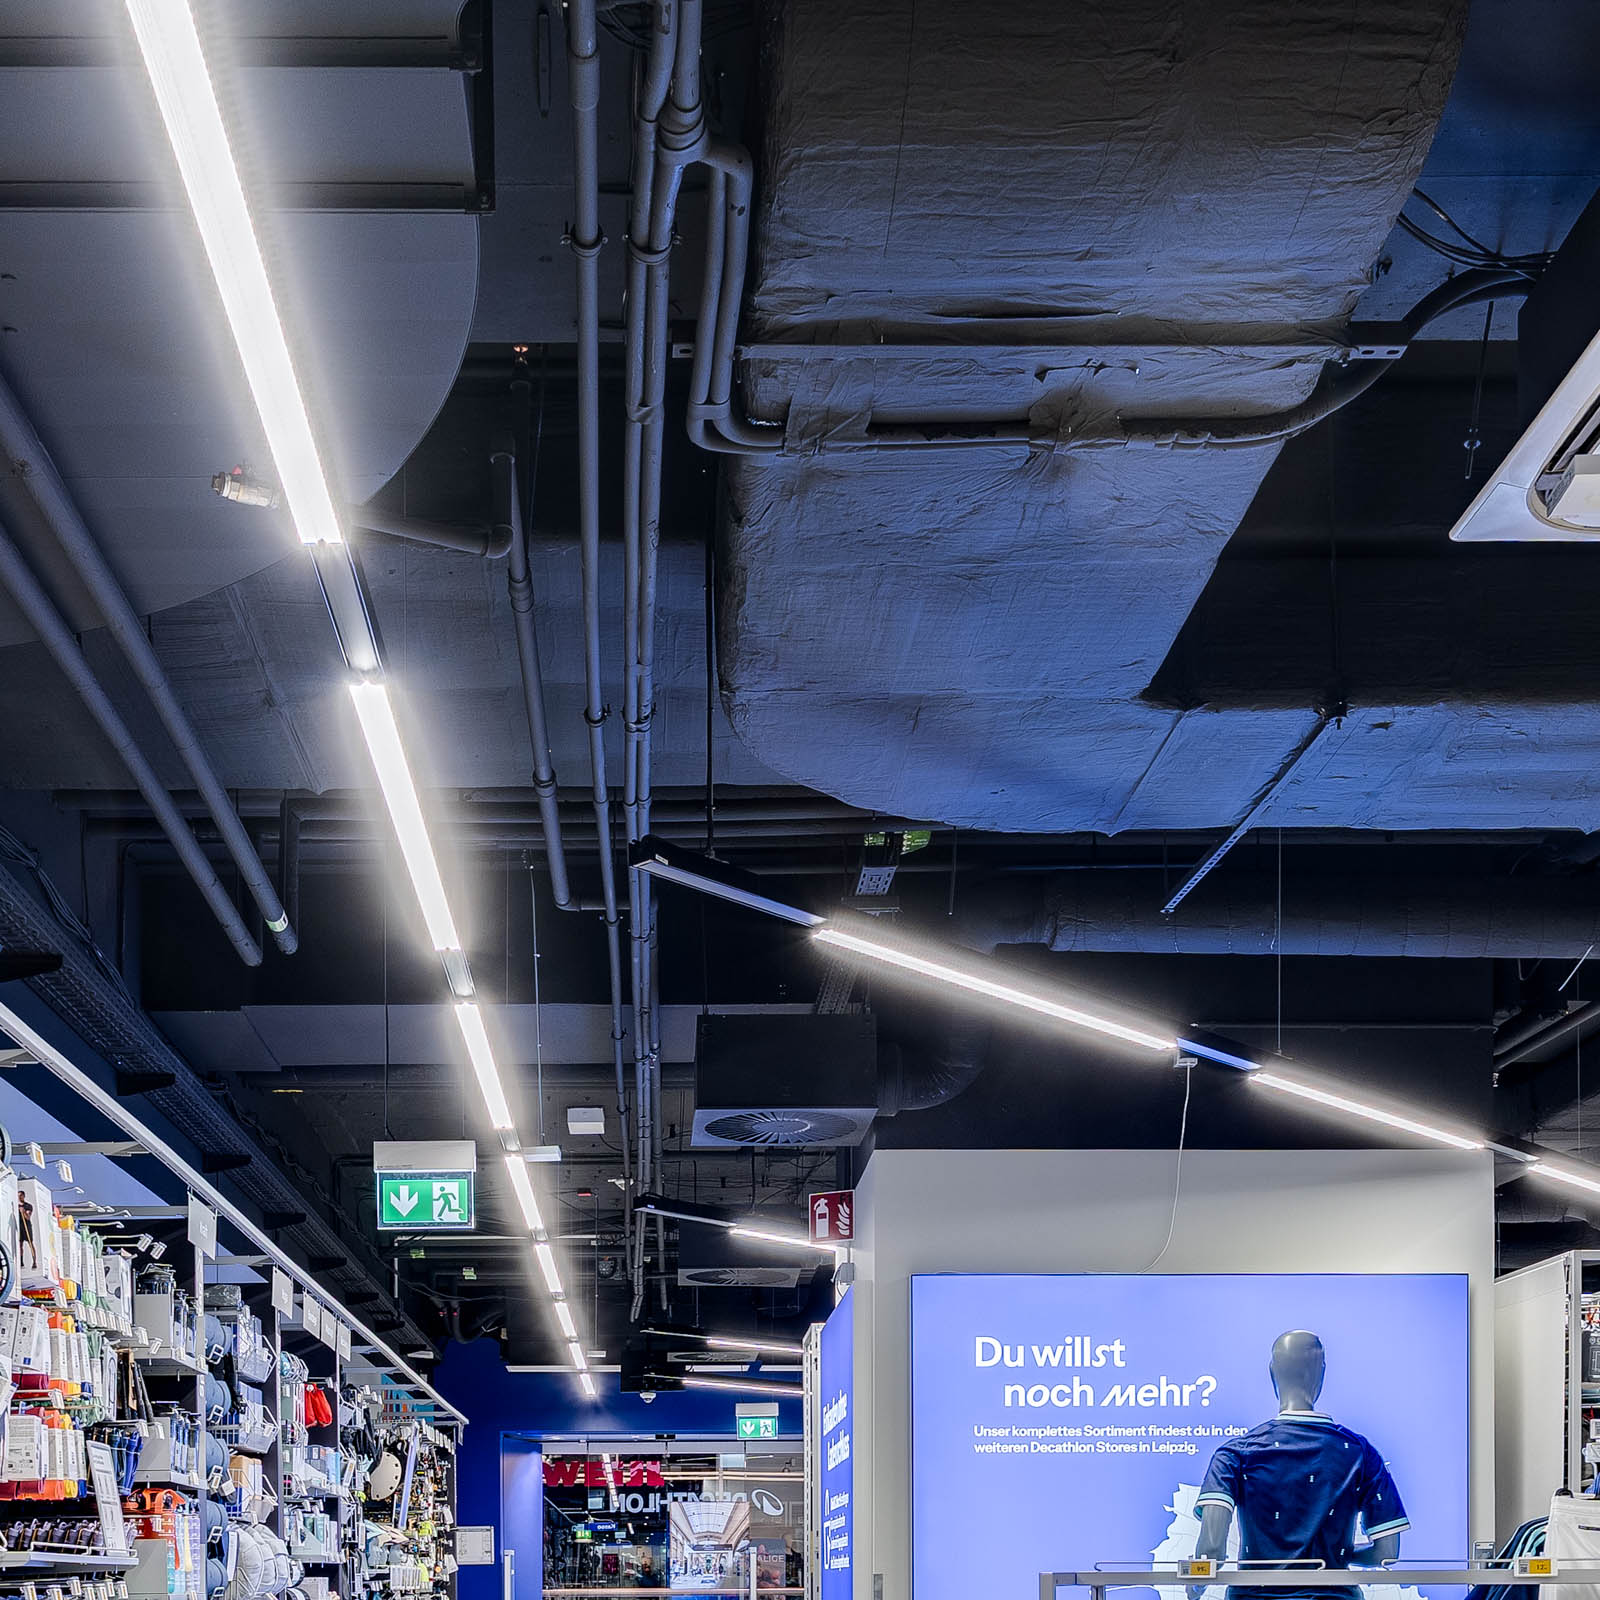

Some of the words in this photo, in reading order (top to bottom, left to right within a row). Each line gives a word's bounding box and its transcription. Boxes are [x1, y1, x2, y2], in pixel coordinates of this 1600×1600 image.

[975, 1336, 1025, 1368] Du
[1031, 1336, 1126, 1368] willst
[1004, 1375, 1094, 1408] noch
[1100, 1375, 1217, 1408] mehr?
[974, 1425, 1011, 1437] Unser
[1012, 1425, 1082, 1440] komplettes
[1084, 1425, 1147, 1437] Sortiment
[1148, 1425, 1193, 1437] findest
[1194, 1425, 1210, 1437] du
[1211, 1425, 1223, 1437] in
[974, 1441, 1029, 1453] weiteren
[1030, 1441, 1095, 1453] Decathlon
[1096, 1441, 1138, 1453] Stores
[1139, 1441, 1150, 1453] in
[1151, 1441, 1199, 1455] Leipzig.
